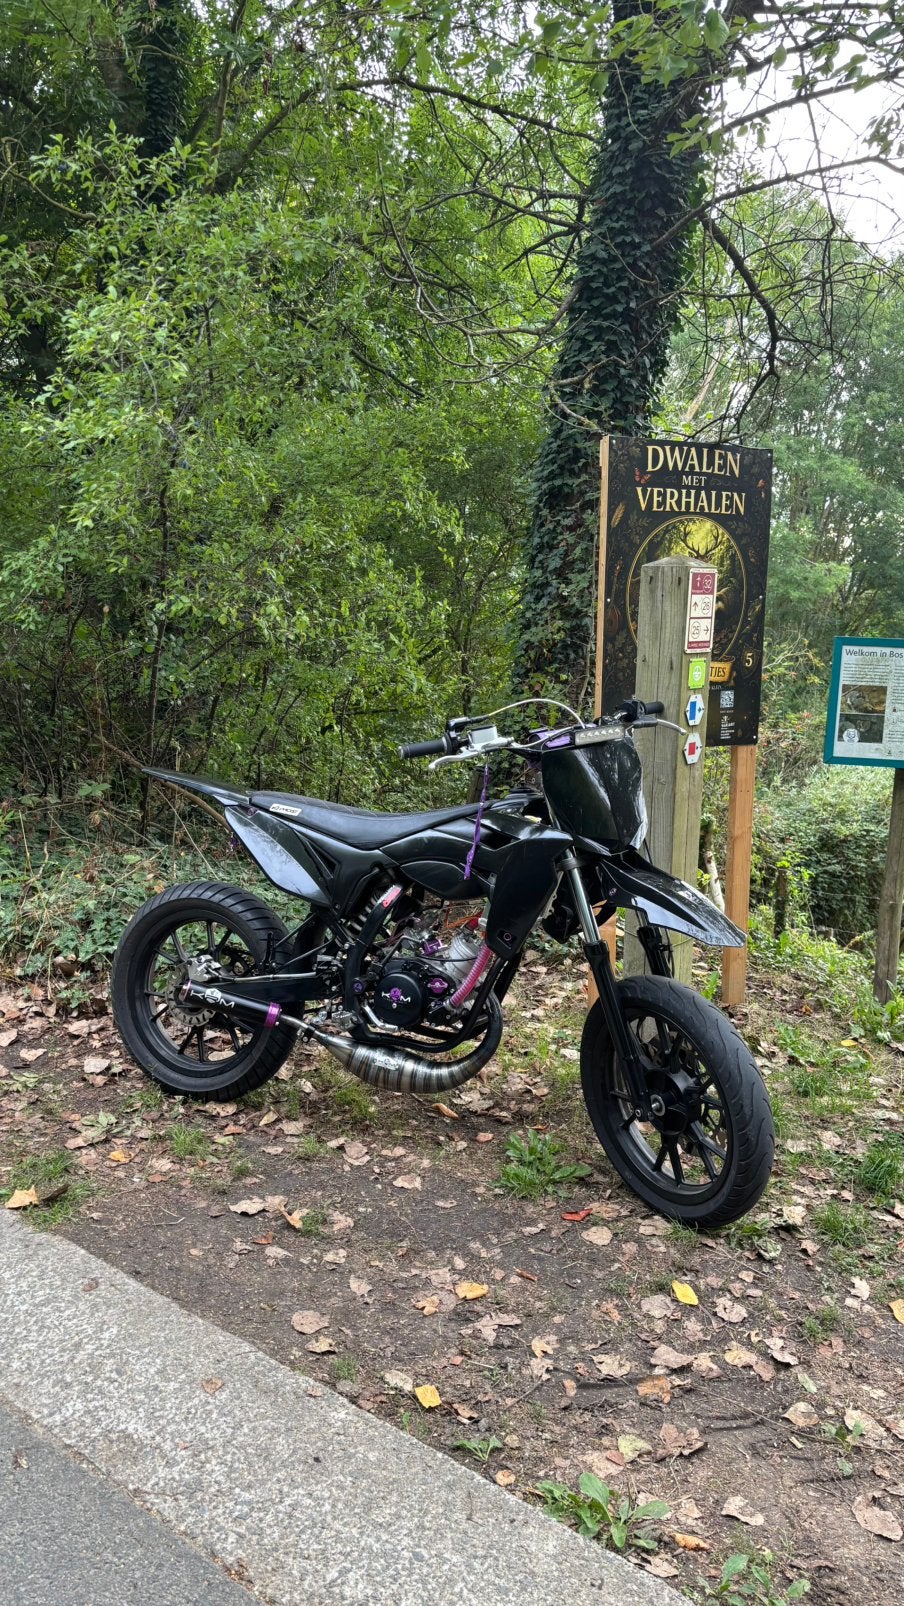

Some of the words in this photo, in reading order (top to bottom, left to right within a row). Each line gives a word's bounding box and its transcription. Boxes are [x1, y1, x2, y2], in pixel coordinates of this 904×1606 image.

[646, 445, 741, 478] DWALEN
[681, 475, 708, 487] MET
[635, 486, 746, 516] VERHALEN
[745, 652, 753, 667] 5
[845, 648, 878, 657] Welkom
[880, 649, 887, 658] in
[889, 650, 904, 659] Bos
